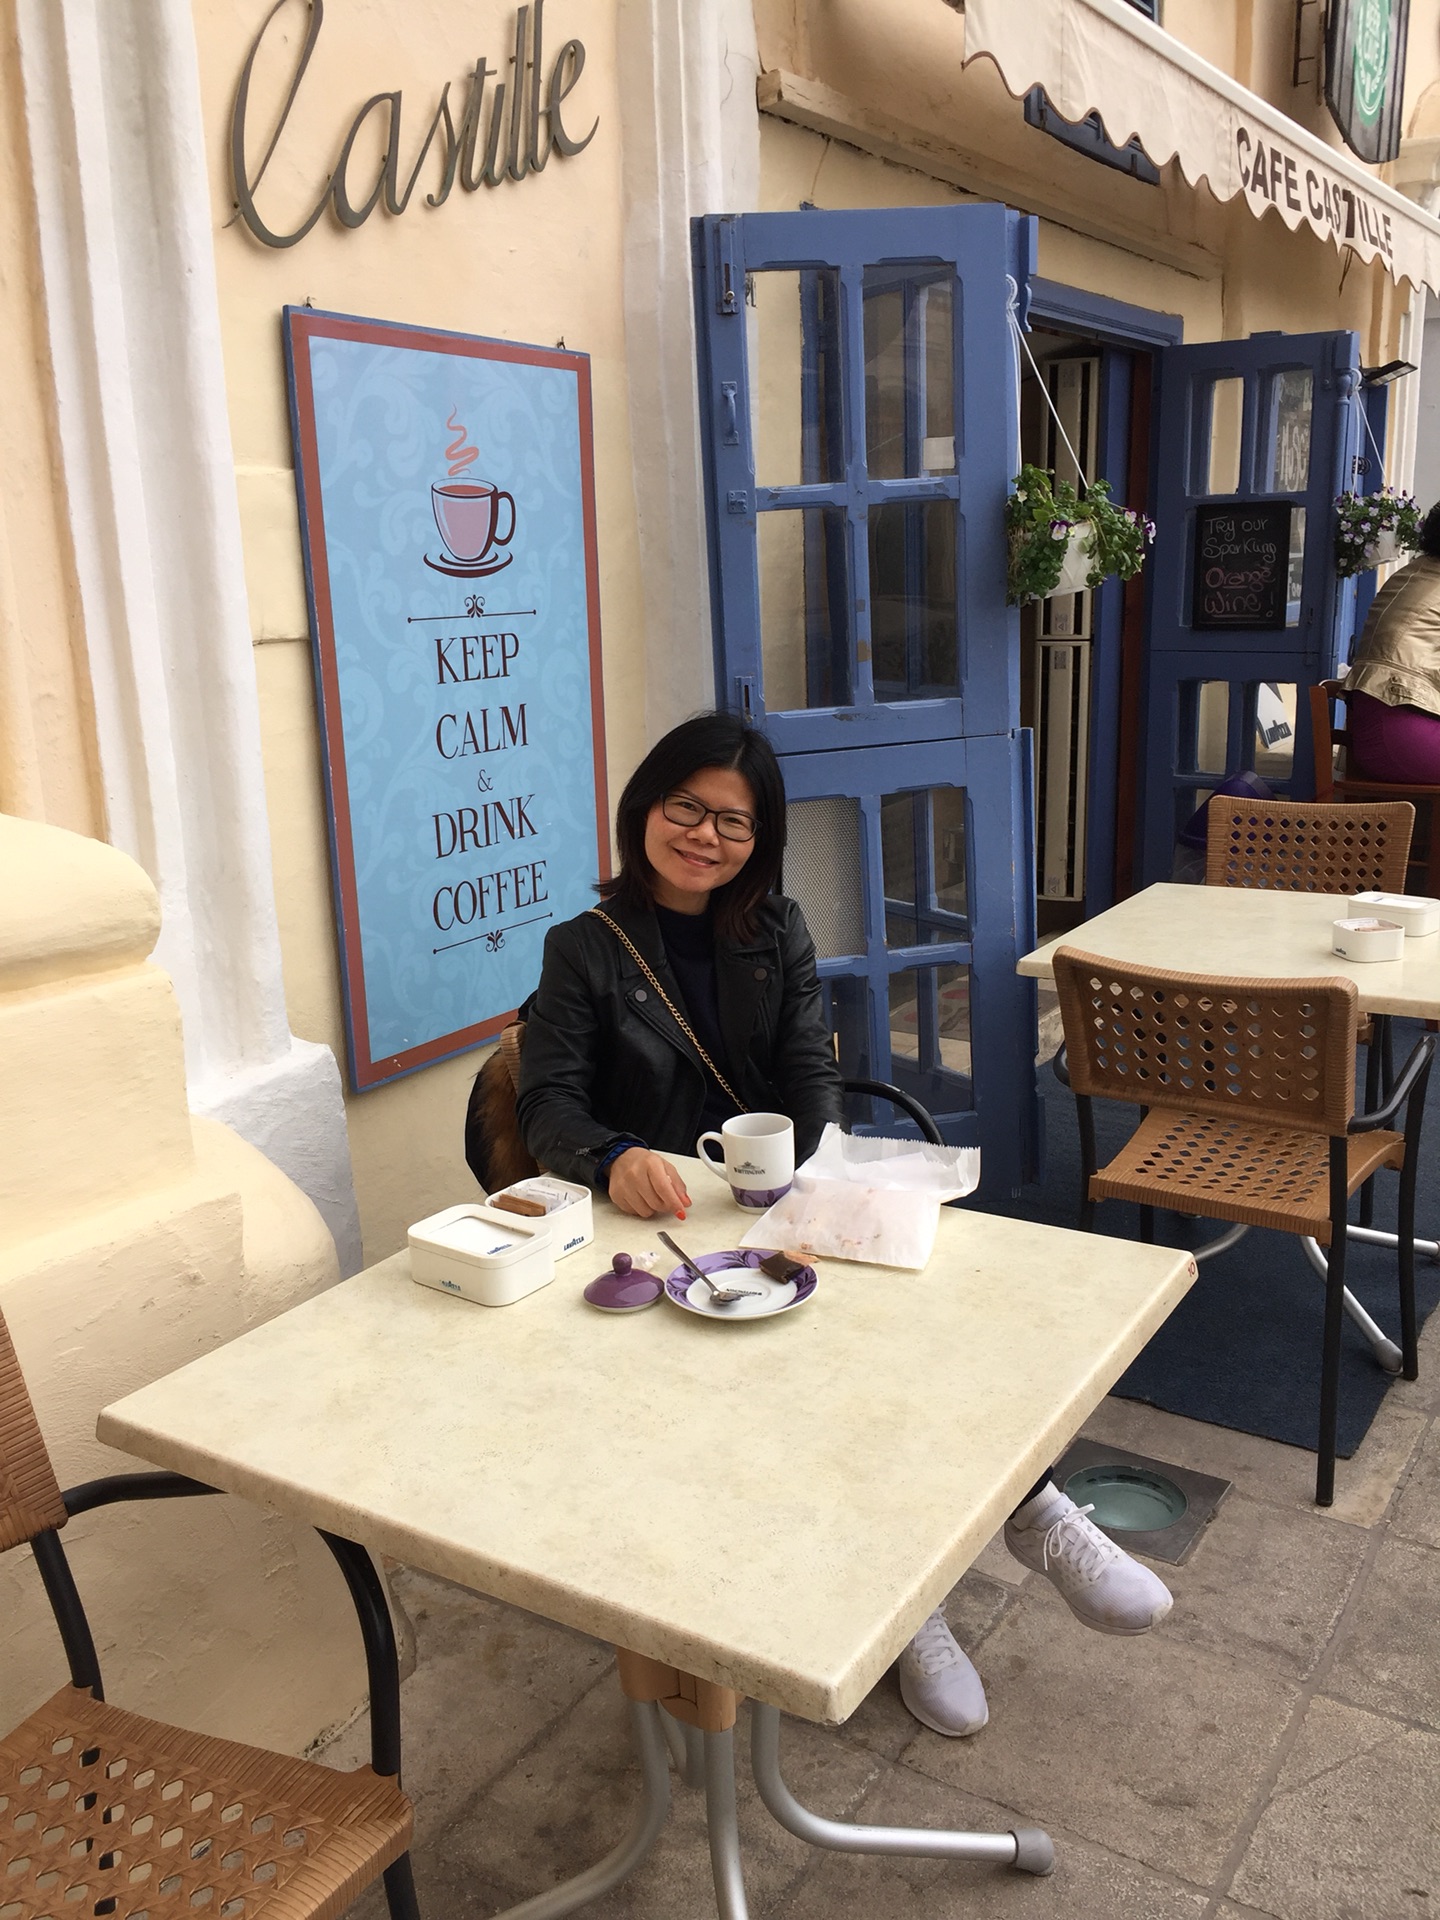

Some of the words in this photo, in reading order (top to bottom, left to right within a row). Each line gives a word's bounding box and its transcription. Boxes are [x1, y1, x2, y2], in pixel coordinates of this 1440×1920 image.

[222, 0, 600, 248] Castille
[1236, 127, 1302, 213] CAFE
[1305, 169, 1394, 259] CASTILLE
[434, 632, 520, 685] KEEP
[435, 703, 529, 760] CALM
[477, 769, 494, 793] &
[432, 794, 539, 860] DRINK
[433, 860, 549, 932] COFFEE
[563, 1236, 586, 1252] LAVAZZA
